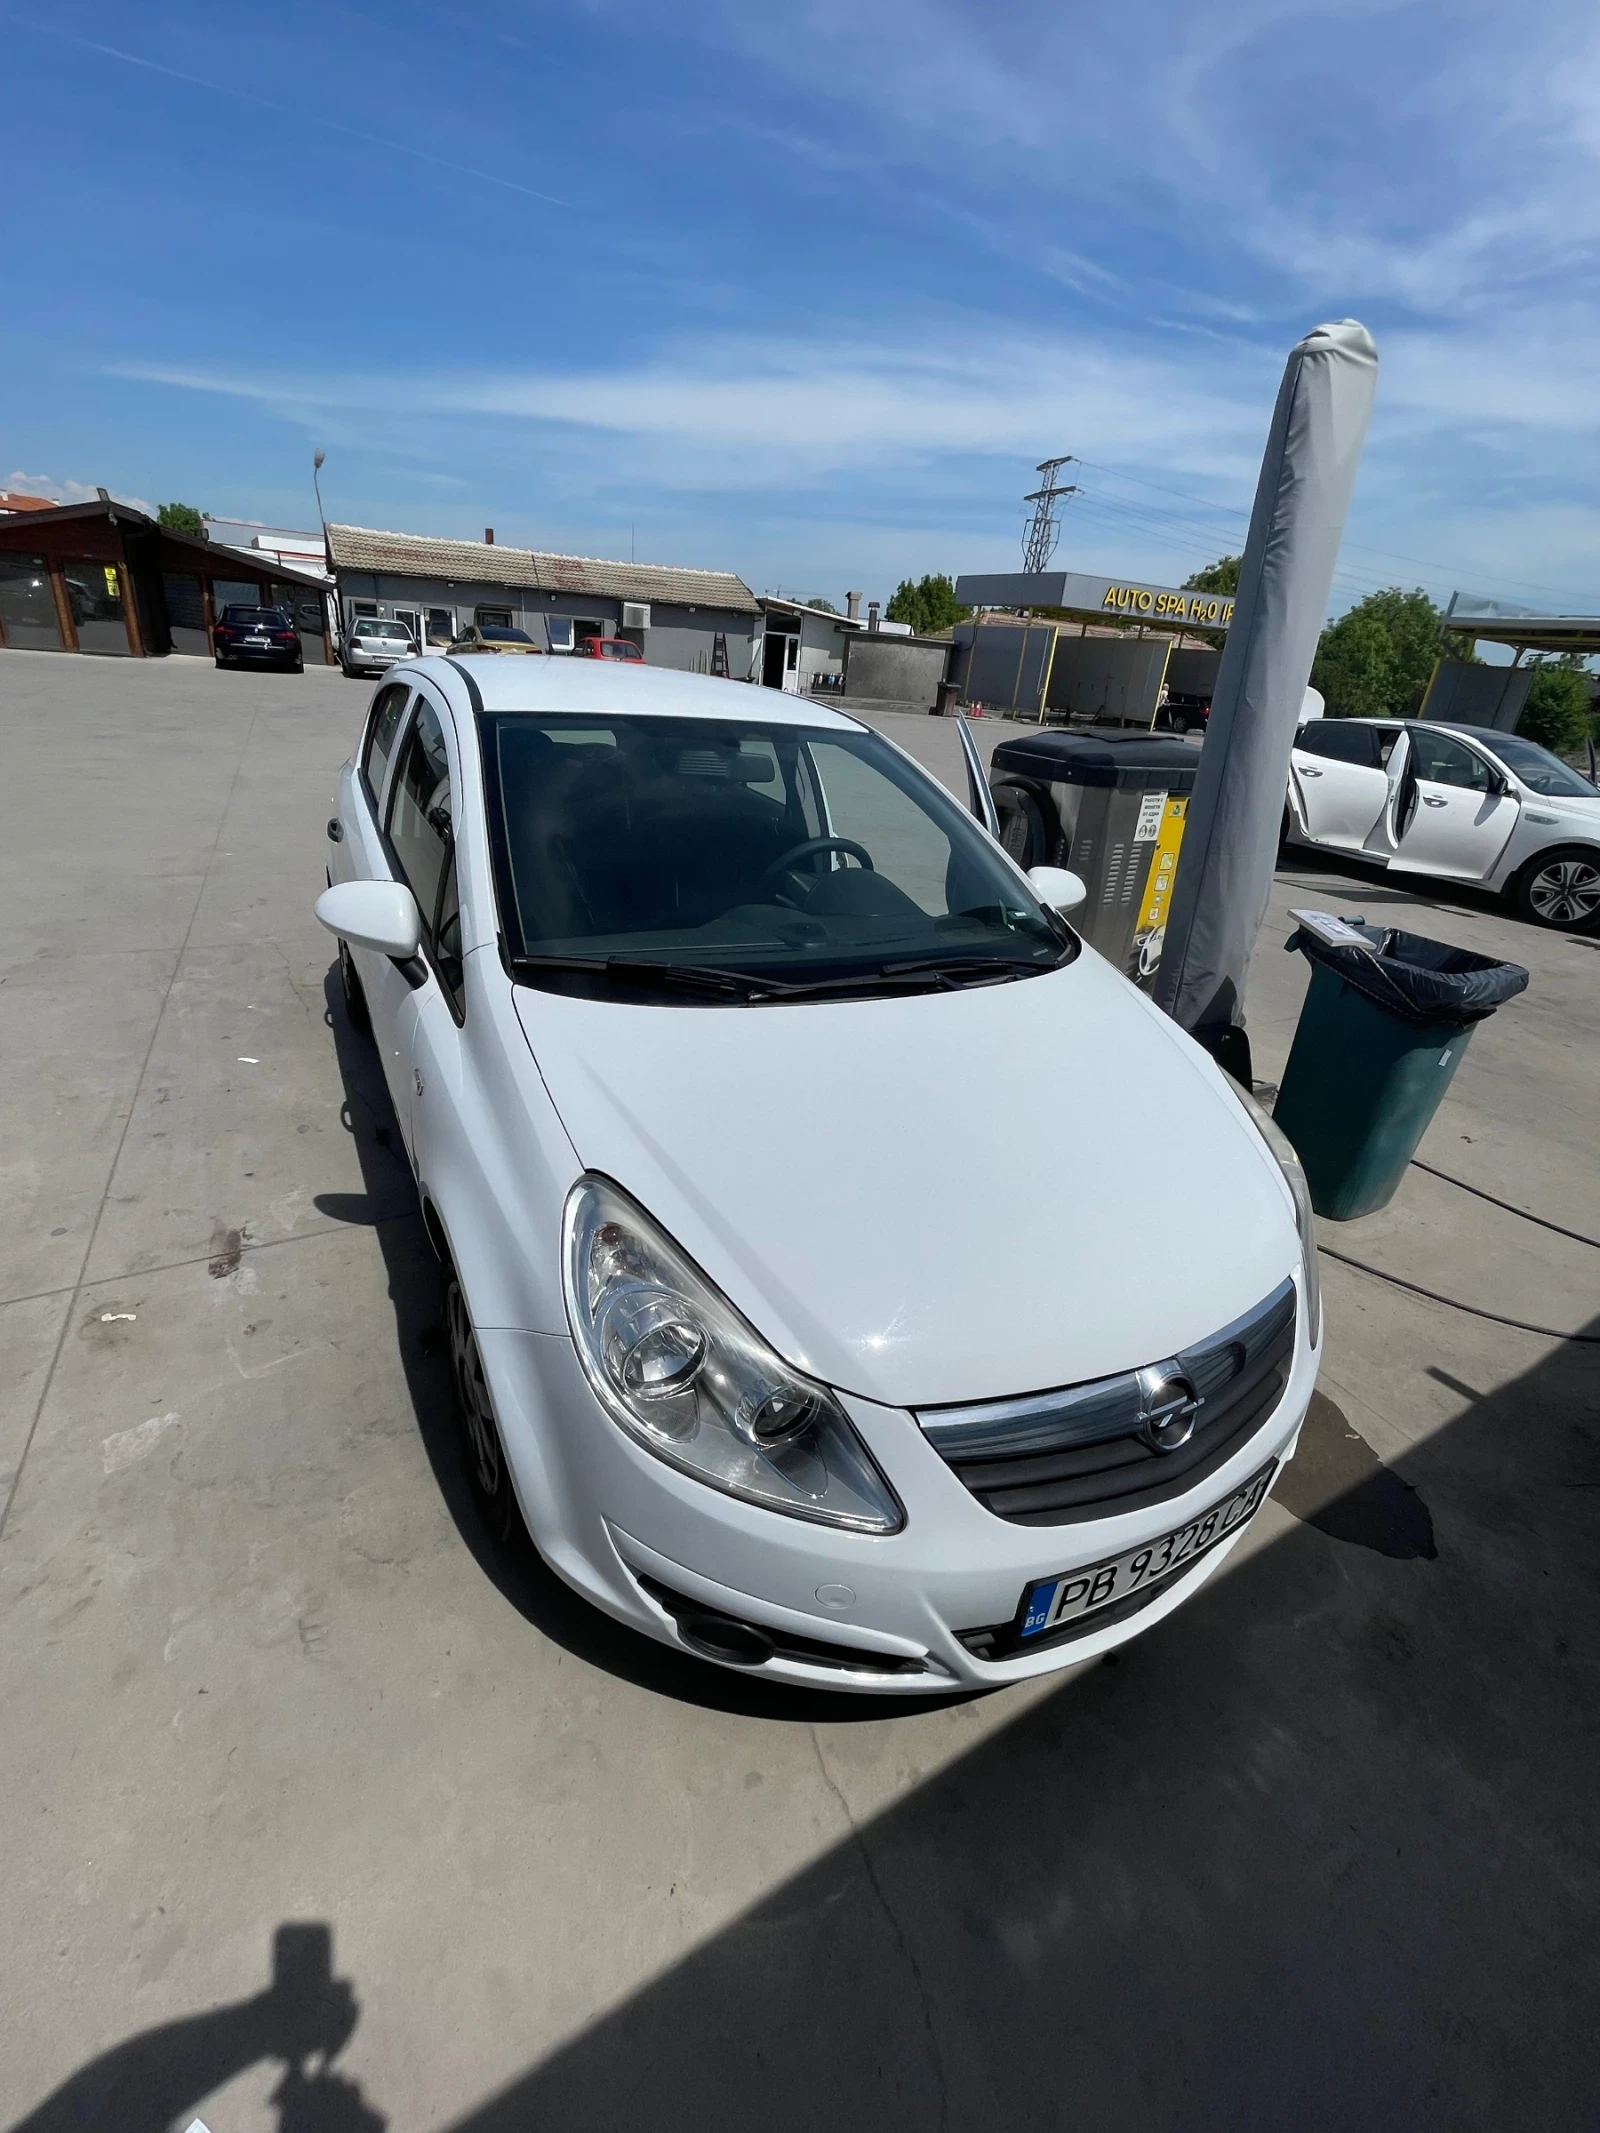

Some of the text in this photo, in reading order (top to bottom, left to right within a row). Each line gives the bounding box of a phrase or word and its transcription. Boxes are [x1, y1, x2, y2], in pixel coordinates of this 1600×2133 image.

[1104, 586, 1153, 611] AUTO
[1156, 594, 1186, 615] SPA
[1053, 1565, 1118, 1621] PB
[1128, 1511, 1220, 1590] 9328
[1024, 1611, 1046, 1628] BG
